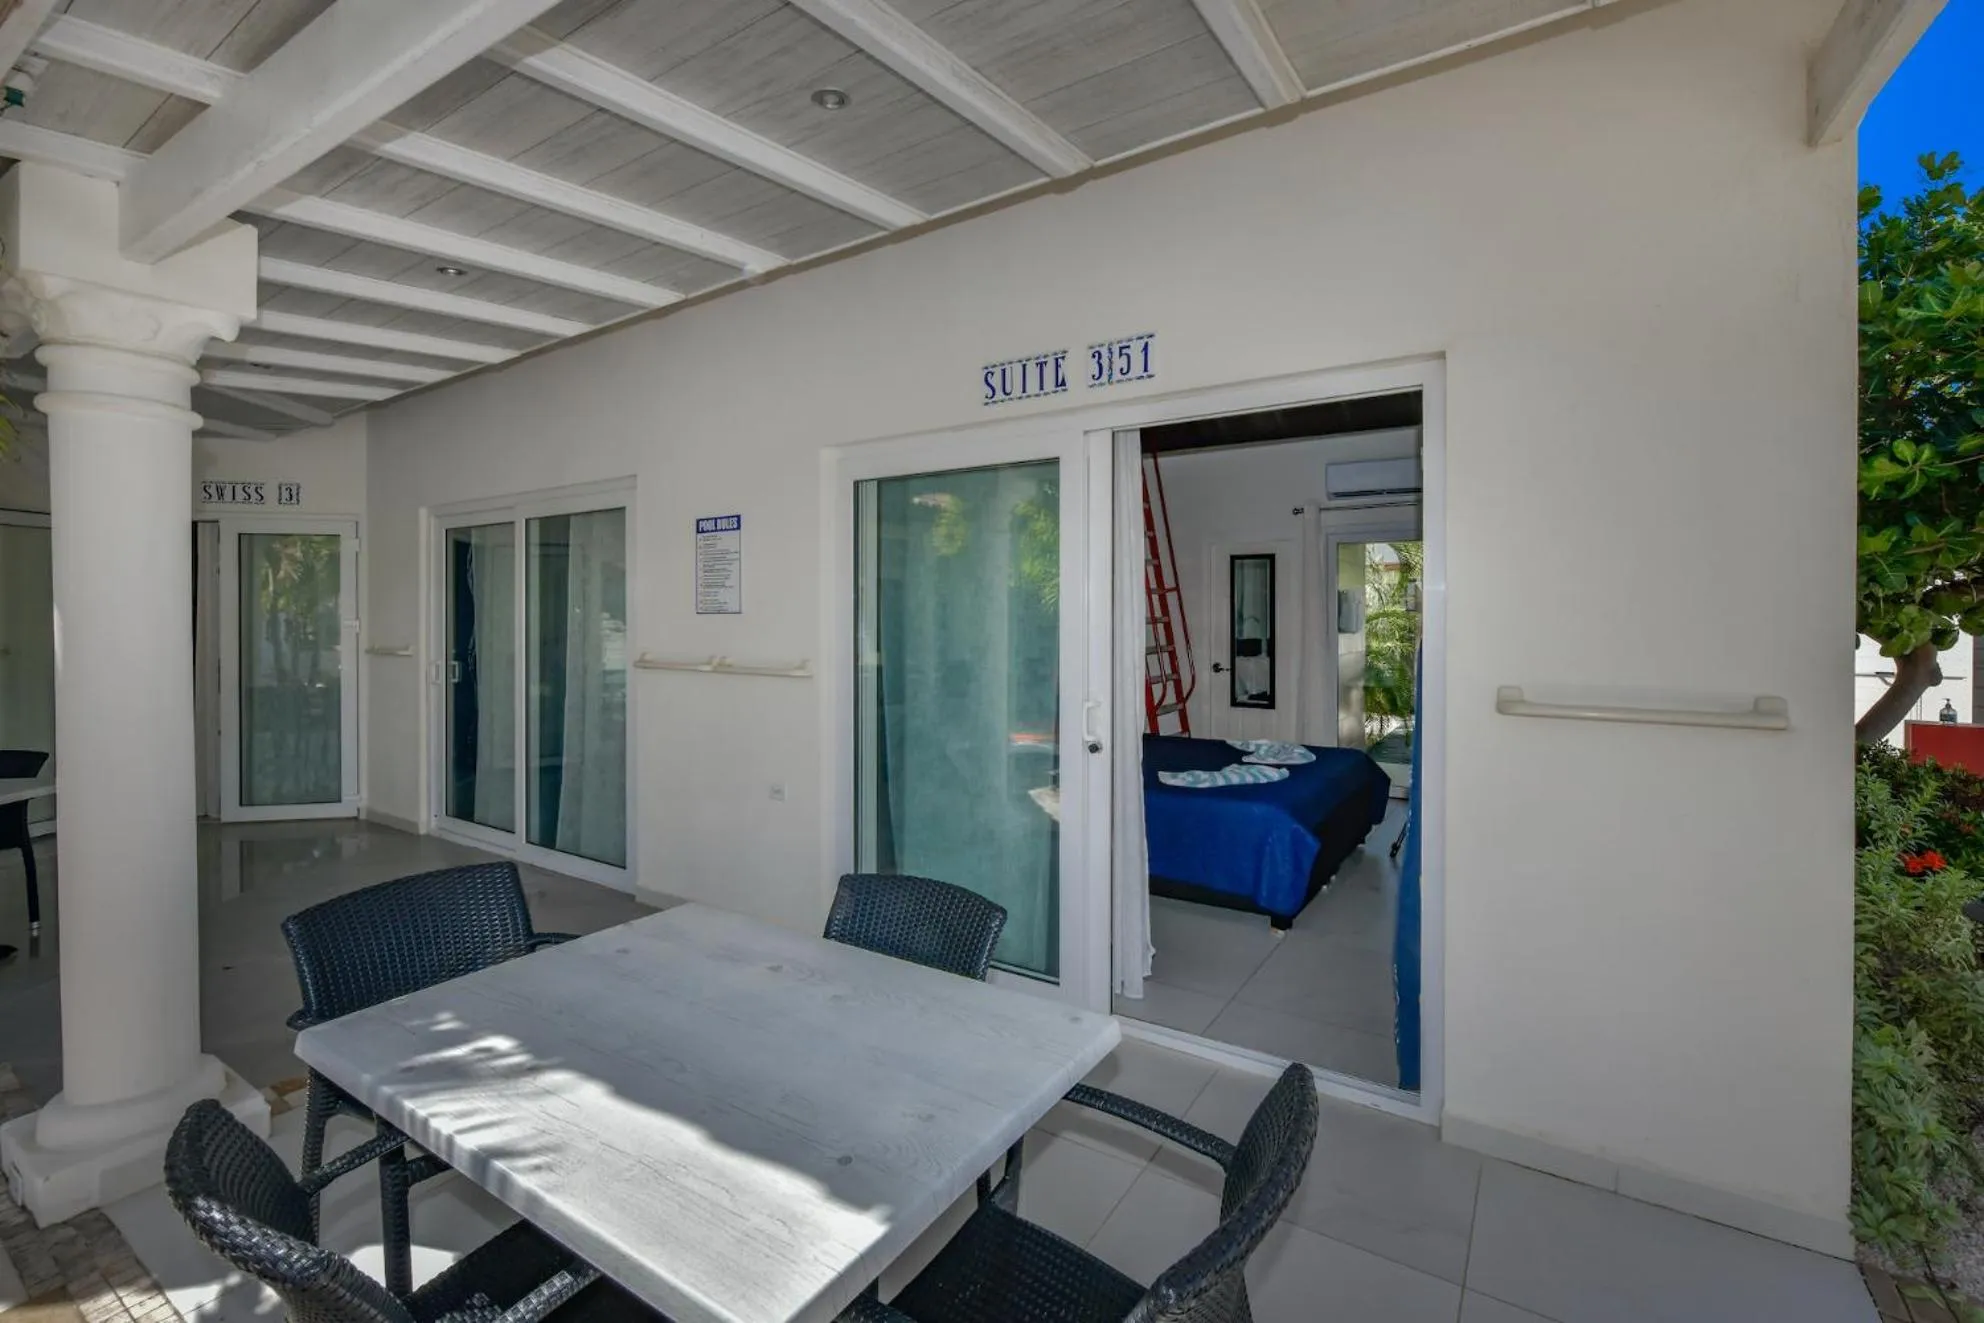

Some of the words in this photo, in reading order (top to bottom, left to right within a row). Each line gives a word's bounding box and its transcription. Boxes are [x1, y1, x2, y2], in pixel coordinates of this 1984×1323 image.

[983, 355, 1067, 400] SUITE
[203, 484, 264, 502] SWISS
[699, 519, 715, 531] POOL
